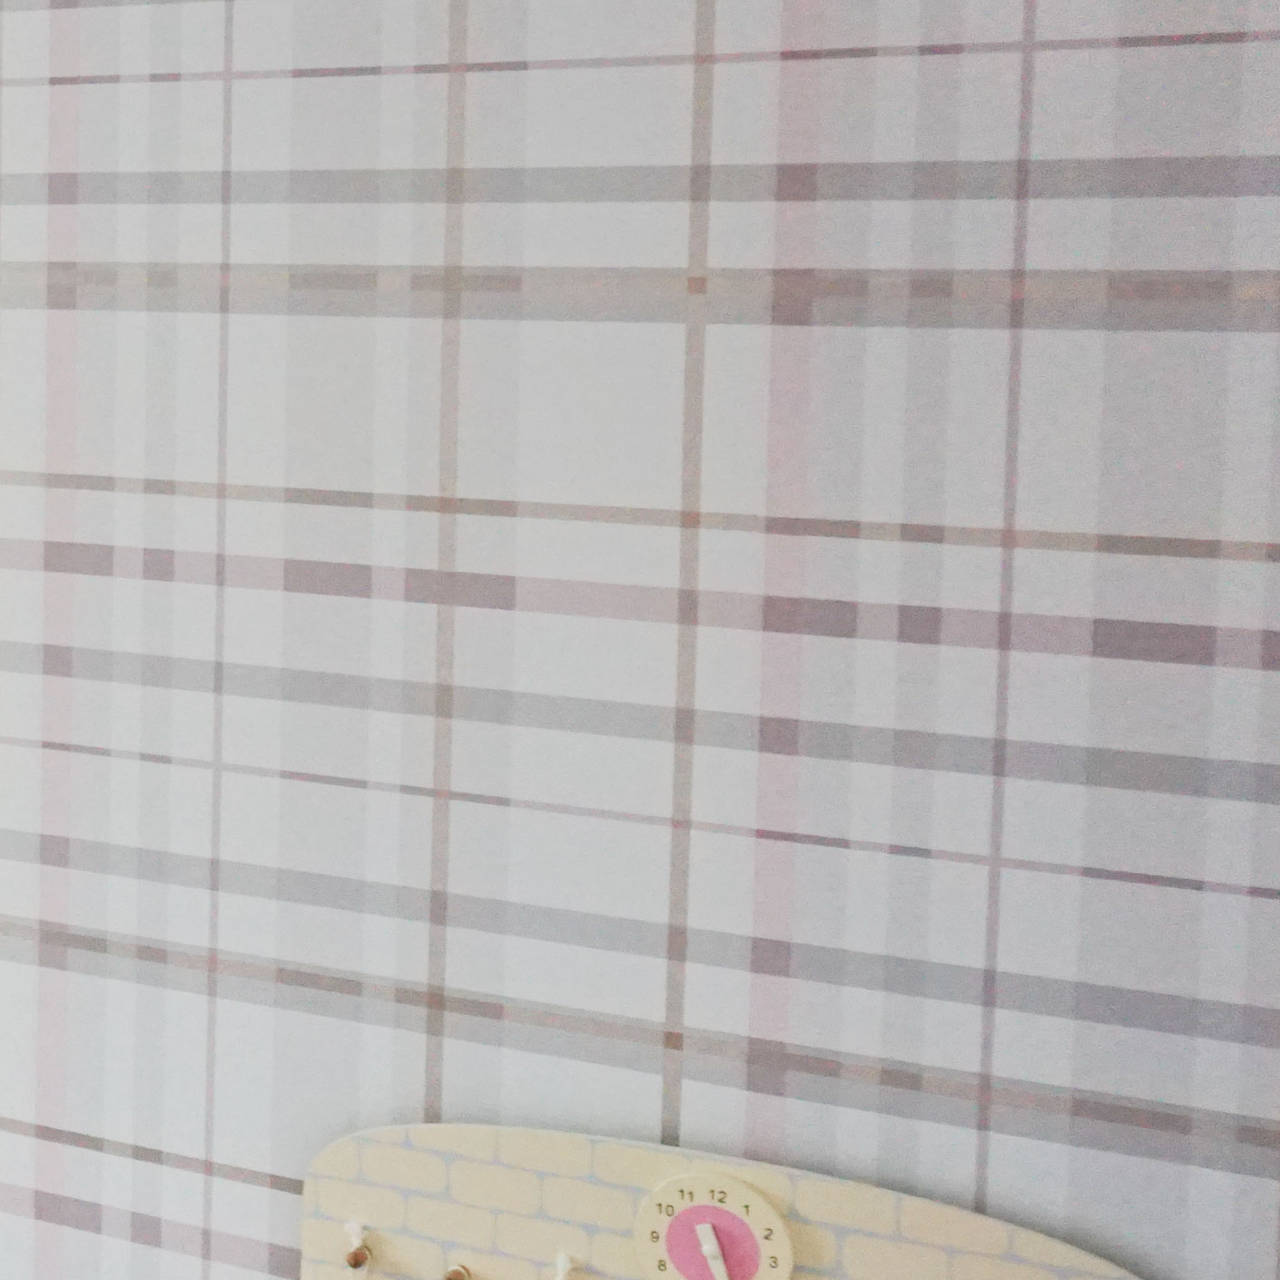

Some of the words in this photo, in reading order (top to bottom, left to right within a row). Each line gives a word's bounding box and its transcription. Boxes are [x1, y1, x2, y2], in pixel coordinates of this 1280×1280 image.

[678, 1189, 694, 1202] 11
[709, 1189, 728, 1204] 12
[656, 1203, 675, 1217] 10
[650, 1231, 660, 1243] 9
[763, 1228, 774, 1241] 2
[657, 1259, 667, 1272] 8
[769, 1256, 779, 1269] 3
